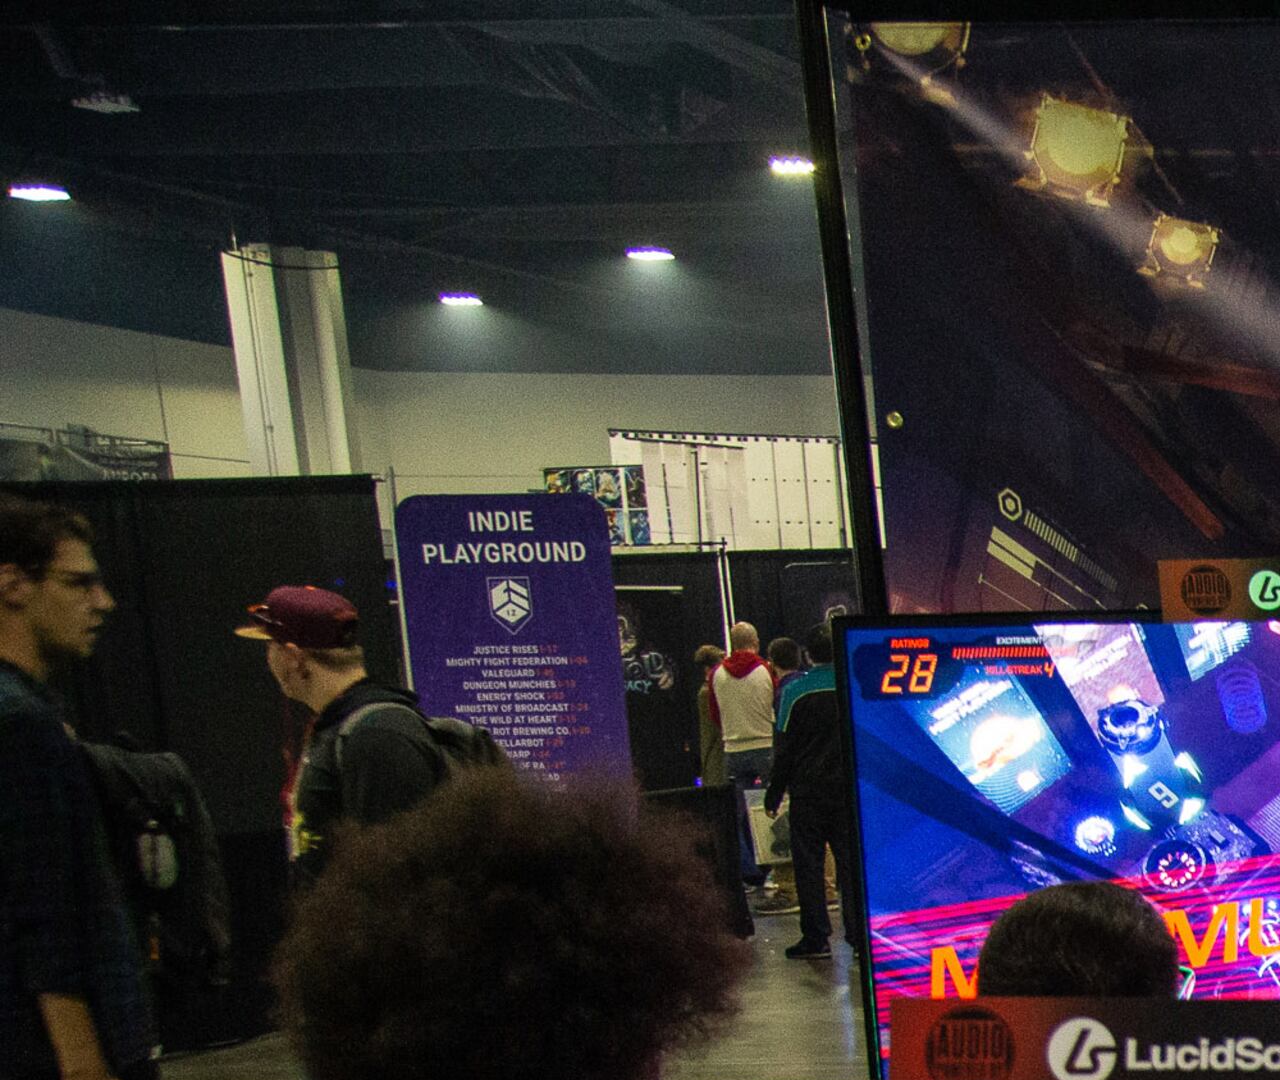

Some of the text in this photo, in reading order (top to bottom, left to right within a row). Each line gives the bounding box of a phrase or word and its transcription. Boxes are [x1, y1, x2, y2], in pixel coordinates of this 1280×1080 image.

[468, 511, 534, 533] INDIE
[422, 541, 587, 564] PLAYGROUND
[891, 638, 930, 649] RATINGS
[473, 645, 510, 655] JUSTICE
[512, 645, 539, 654] RISES
[446, 657, 481, 667] MIGHTY
[483, 657, 510, 666] FIGHT
[512, 656, 568, 666] FEDERATION
[481, 669, 535, 678] VALEGUARD
[881, 654, 938, 694] 28
[463, 681, 507, 690] DUNGEON
[509, 680, 556, 689] MUNCHIES
[477, 693, 512, 702] ENERGY
[514, 692, 545, 701] SHOCK
[501, 704, 513, 713] OF
[515, 703, 569, 713] BROADCAST
[470, 716, 488, 725] THE
[490, 716, 512, 725] WILD
[514, 716, 525, 724] AT
[528, 715, 557, 724] HEART
[513, 727, 554, 736] BREWING
[934, 1018, 1002, 1059] AUDIO
